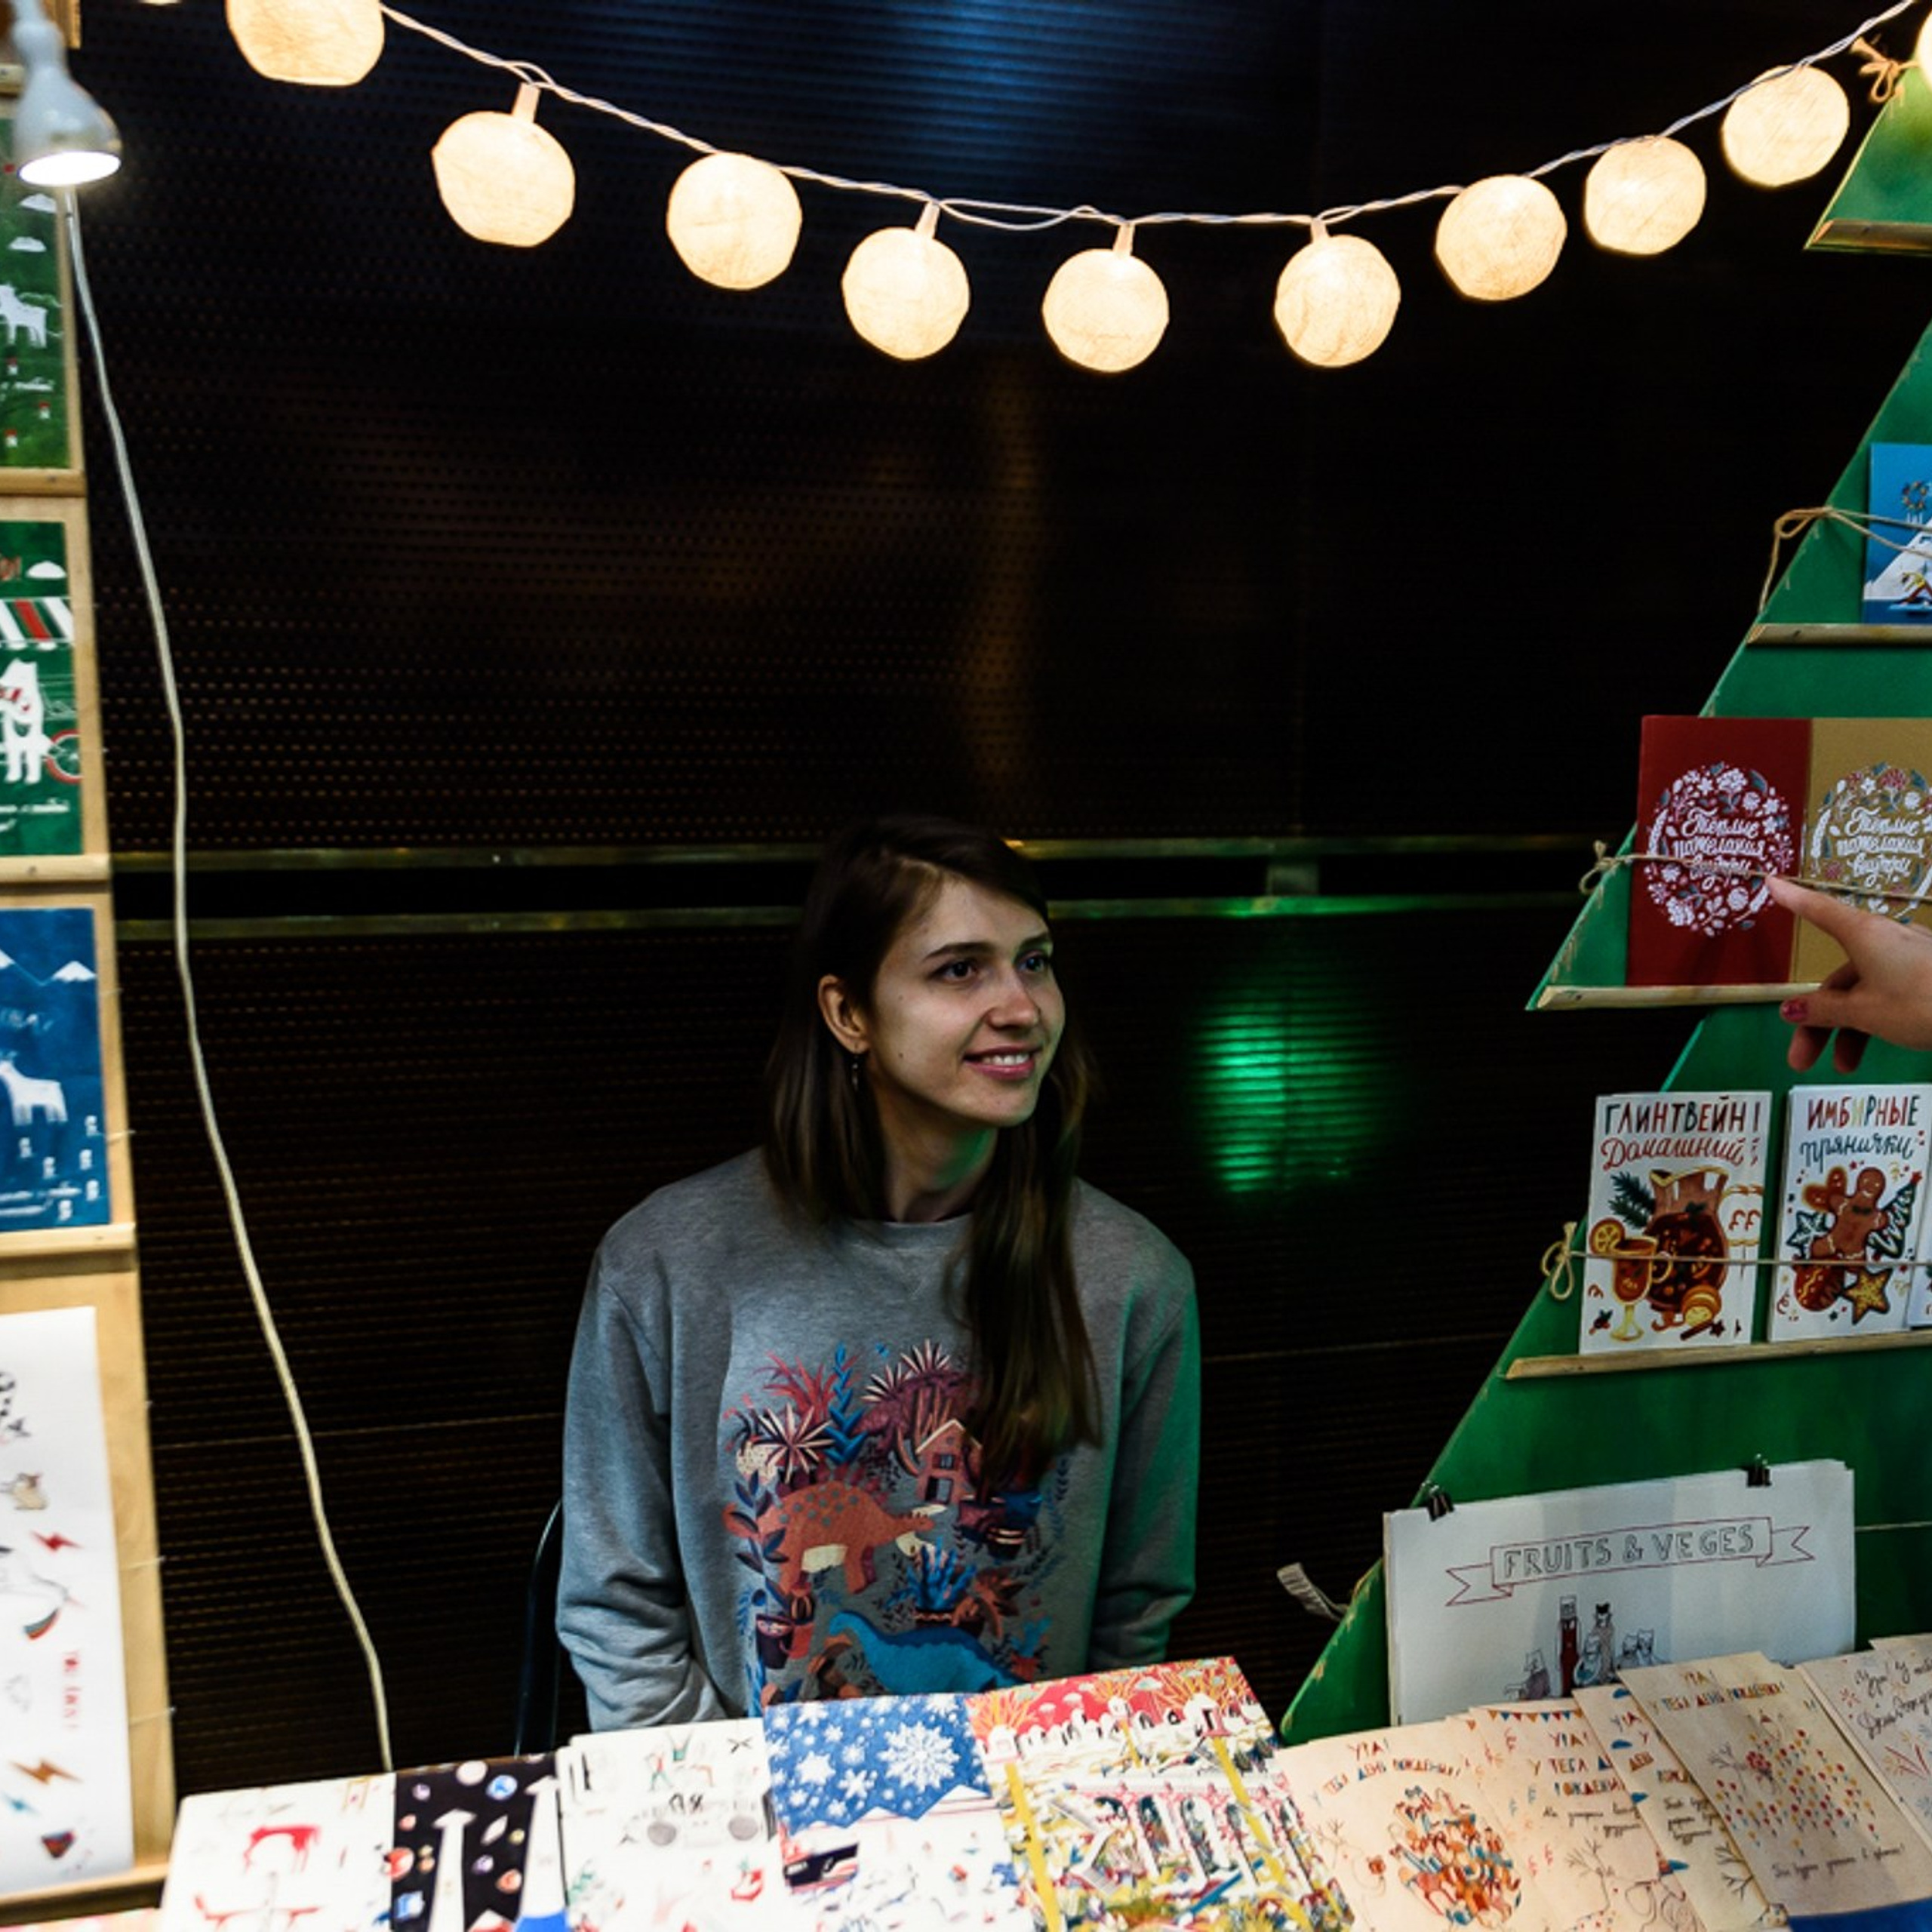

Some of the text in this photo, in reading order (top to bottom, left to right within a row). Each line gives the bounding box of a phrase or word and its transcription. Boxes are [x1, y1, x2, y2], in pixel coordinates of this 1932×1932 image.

[1806, 1094, 1921, 1131] ИМБИРНЫЕ
[1799, 1132, 1915, 1174] прянички
[1503, 1537, 1613, 1579] FRUITS
[1623, 1534, 1644, 1564] &
